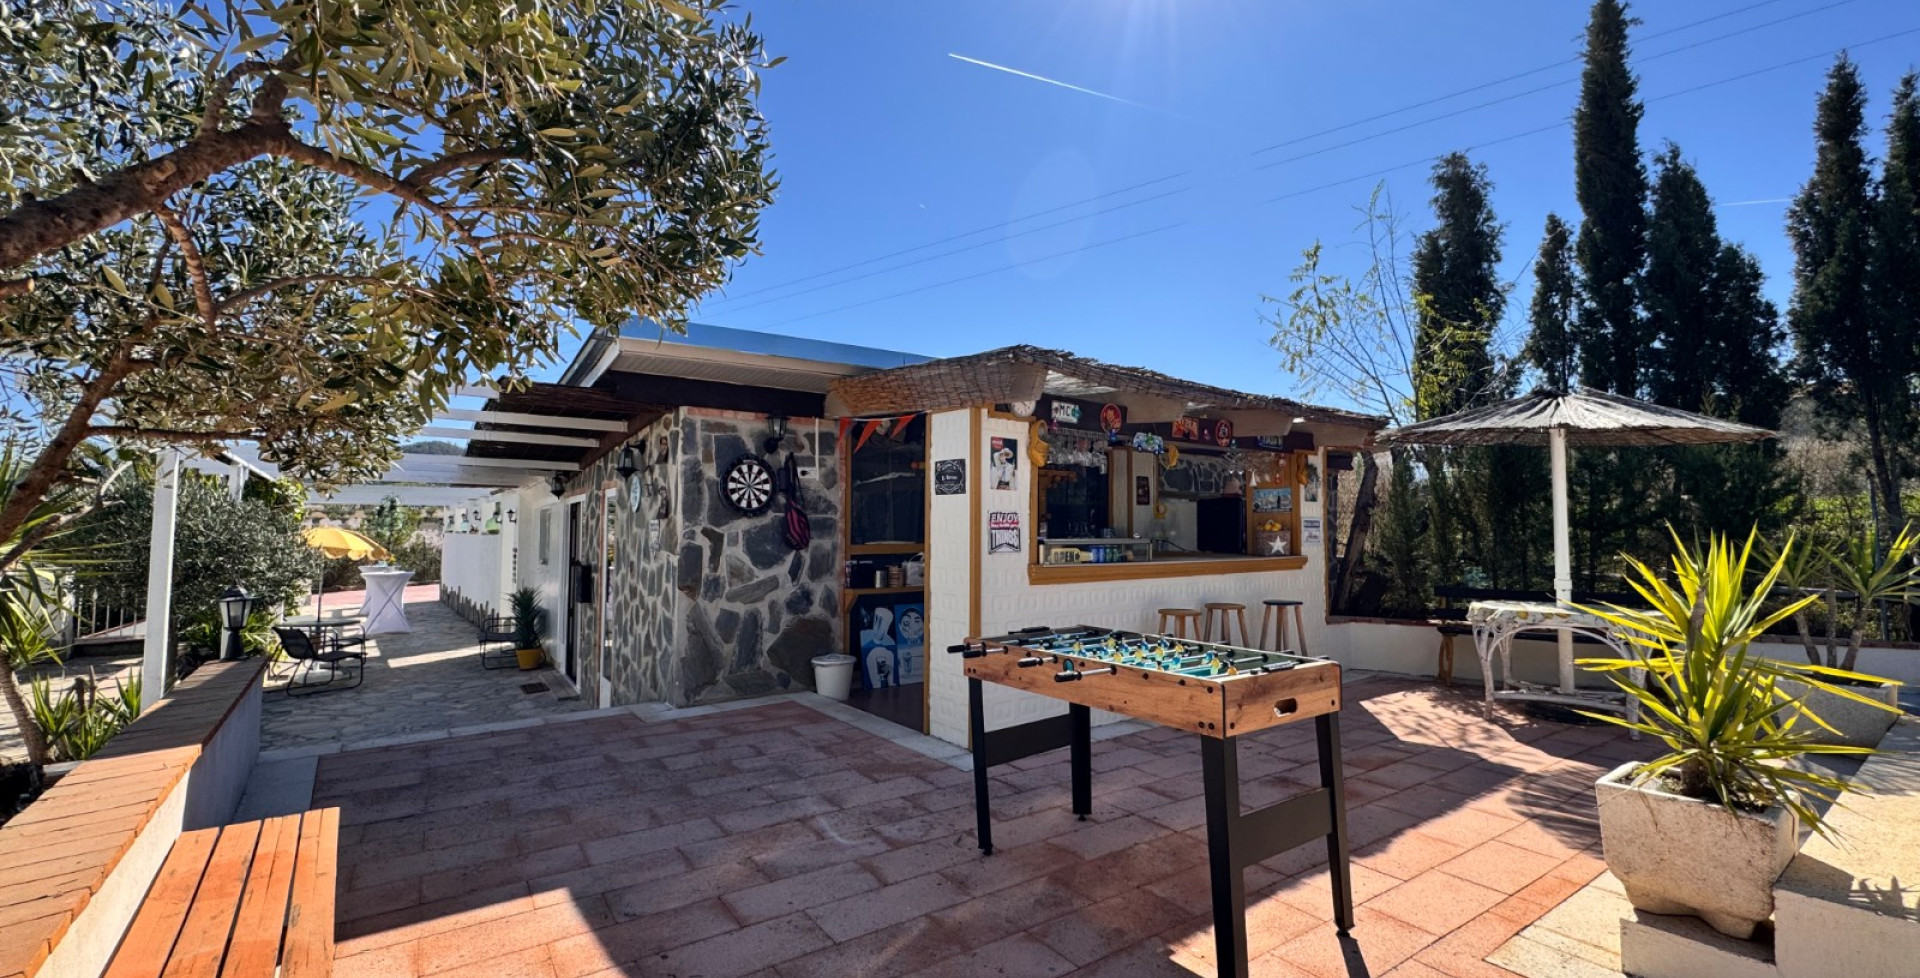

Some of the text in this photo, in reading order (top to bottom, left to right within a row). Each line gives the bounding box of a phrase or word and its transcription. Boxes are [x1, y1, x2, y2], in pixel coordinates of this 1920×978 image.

[991, 512, 1018, 522] ENJOY
[991, 529, 1019, 549] THINGS
[1054, 551, 1075, 562] OPEN
